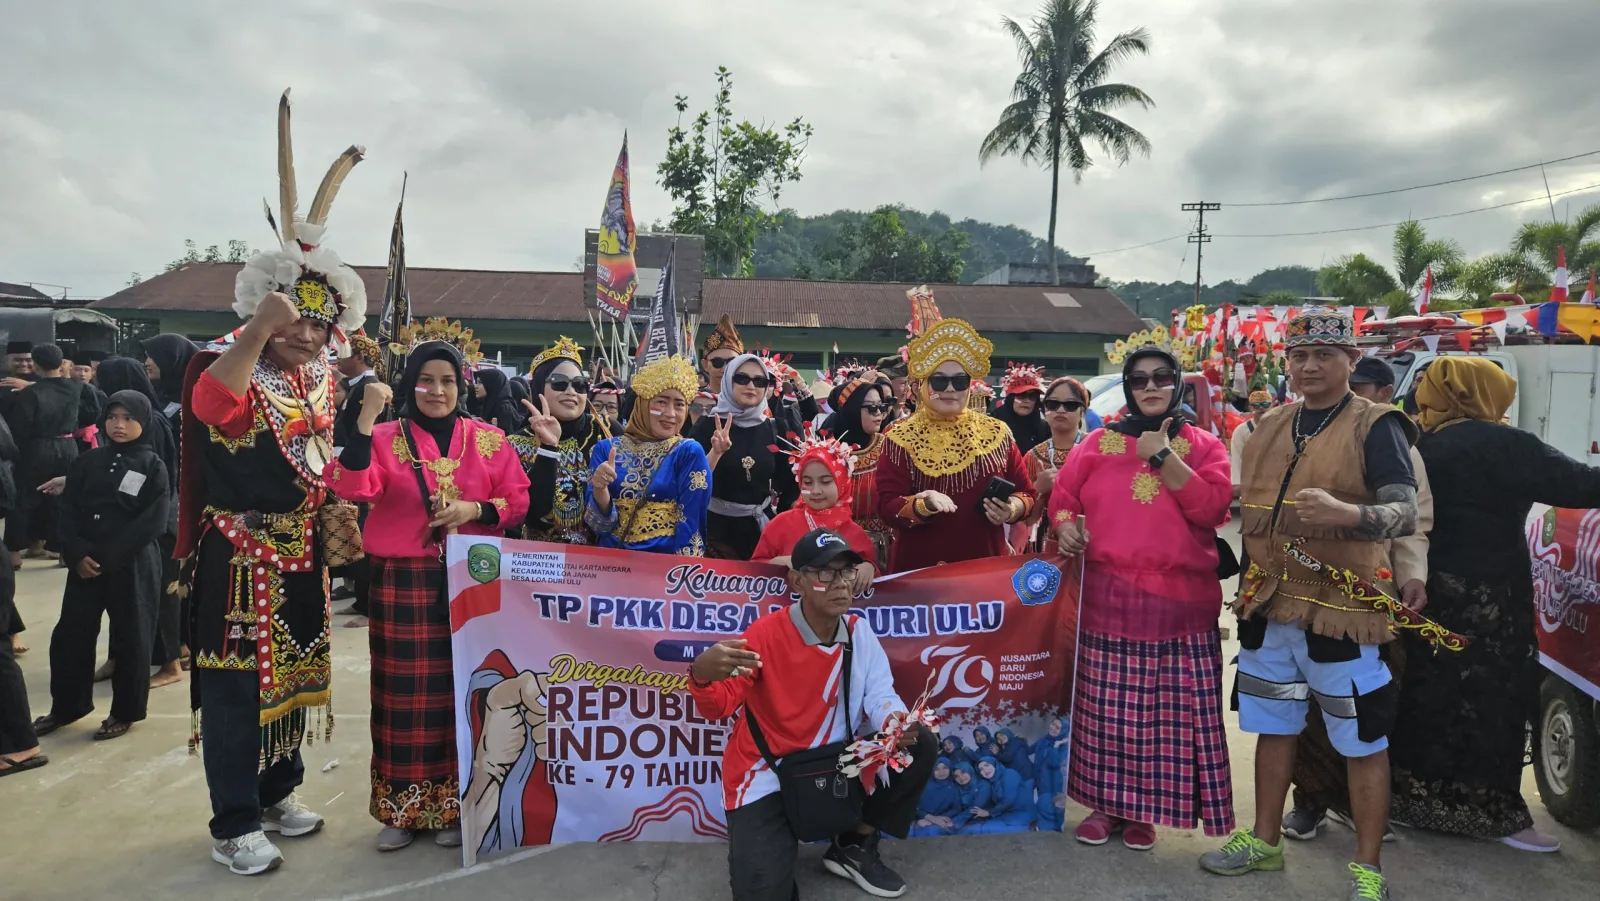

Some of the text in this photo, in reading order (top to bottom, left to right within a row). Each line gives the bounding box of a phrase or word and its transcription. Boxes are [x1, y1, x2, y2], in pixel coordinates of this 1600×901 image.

[512, 552, 559, 560] PEMERINTAH
[511, 560, 555, 568] KABUPATEN
[579, 564, 632, 573] KARTANEGARA
[511, 568, 555, 576] KECAMATAN
[665, 564, 787, 602] Keluarga
[532, 592, 582, 622] TP
[587, 596, 666, 631] PKK
[670, 601, 760, 634] DESA
[932, 600, 1004, 635] ULU
[1000, 651, 1051, 662] NUSANTARA
[1000, 664, 1025, 672] BARU
[999, 670, 1045, 681] INDONESIA
[998, 683, 1024, 691] MAJU
[546, 684, 744, 727] REPUBL
[547, 724, 733, 762] INDONE
[548, 763, 577, 785] KE
[605, 764, 635, 788] 79
